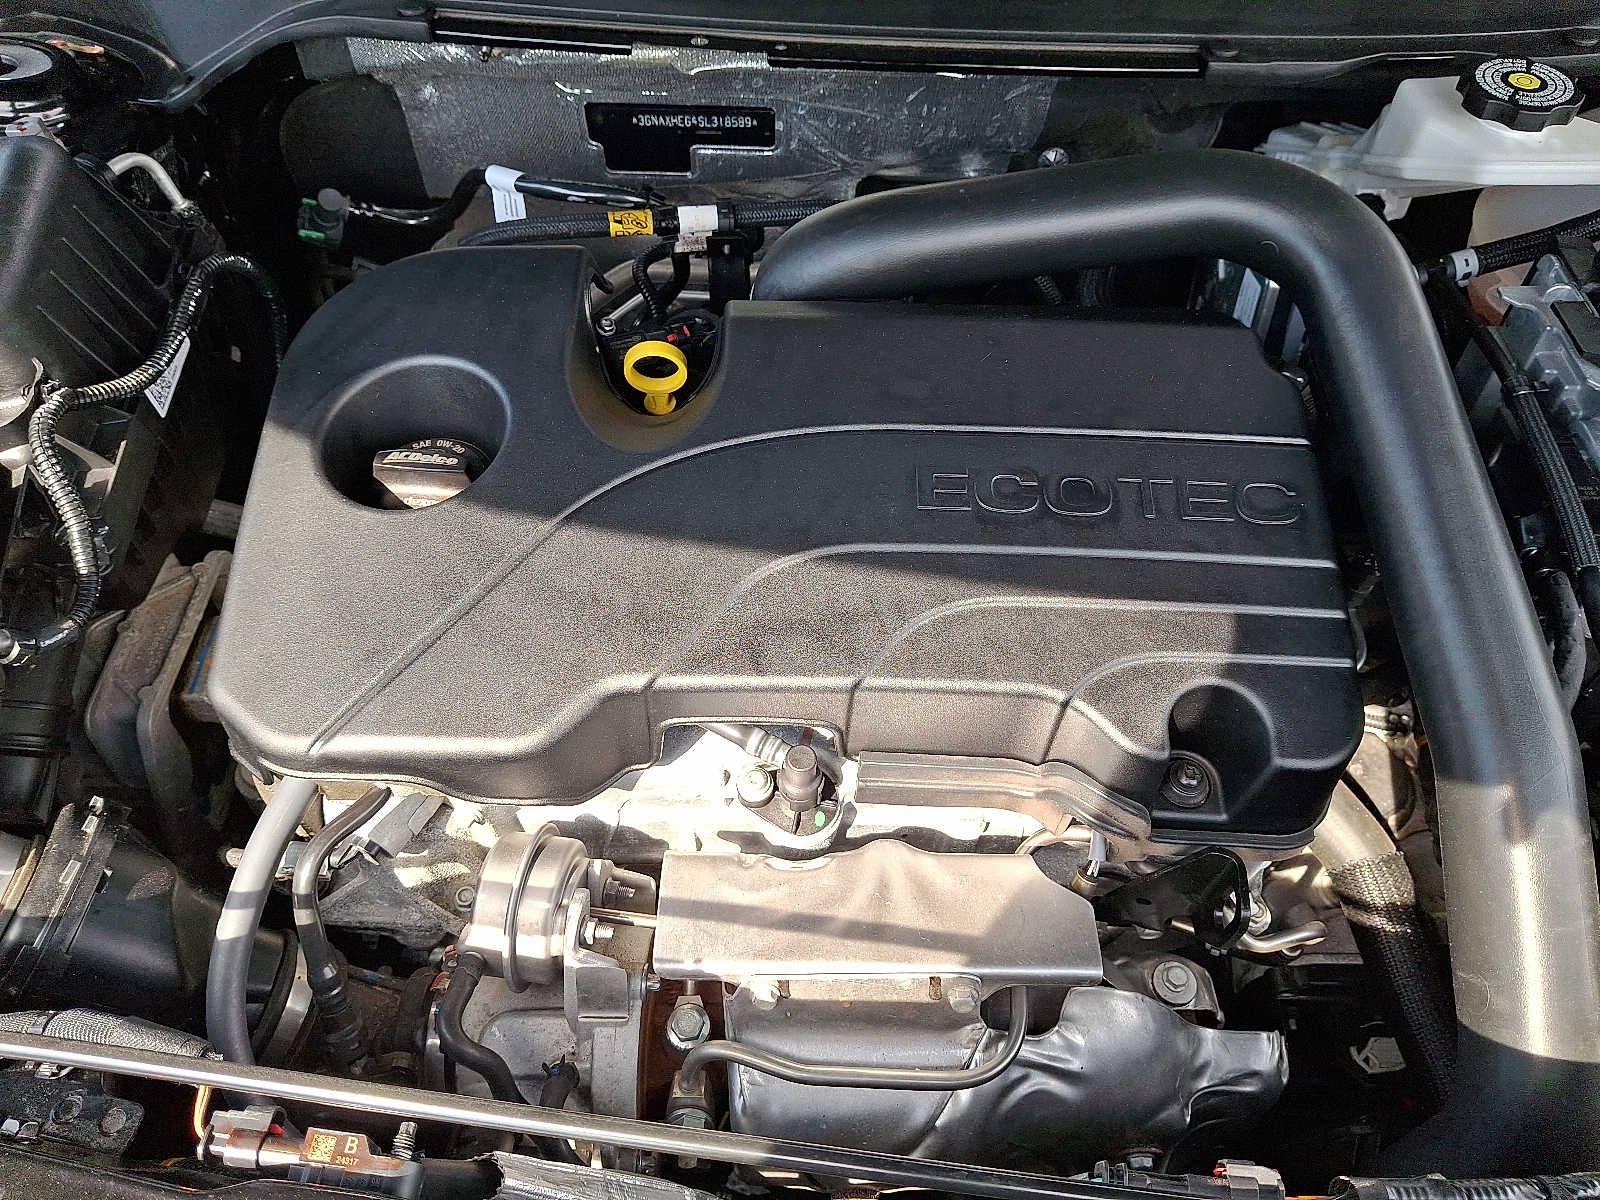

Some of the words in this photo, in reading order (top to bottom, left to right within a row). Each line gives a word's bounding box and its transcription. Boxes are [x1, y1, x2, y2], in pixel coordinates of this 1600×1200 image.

[412, 439, 432, 450] SAE
[436, 439, 466, 455] 0W-20
[382, 452, 459, 466] ACDelco
[916, 467, 1299, 525] ECOTEC
[344, 1136, 359, 1154] B
